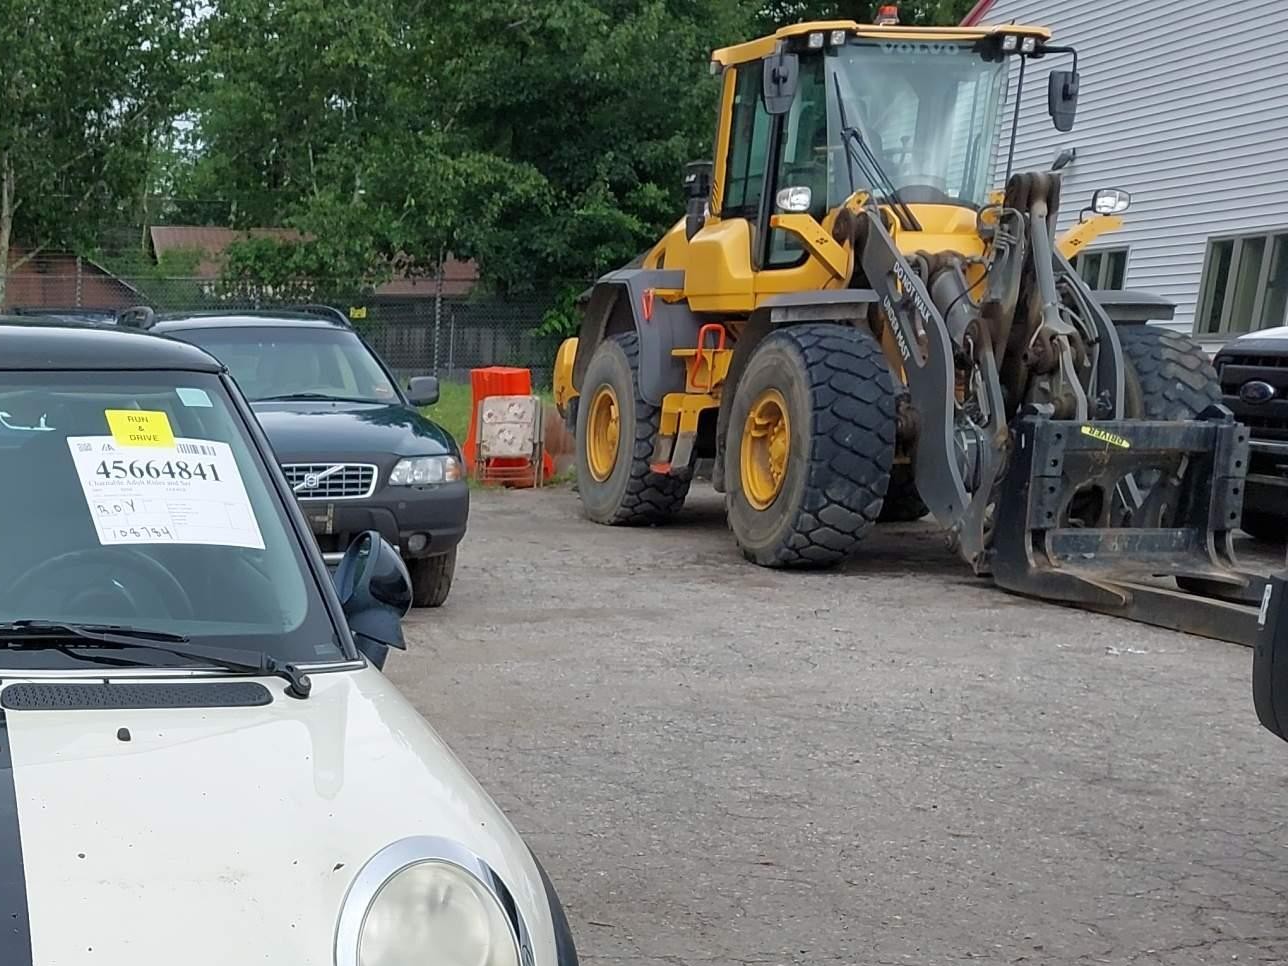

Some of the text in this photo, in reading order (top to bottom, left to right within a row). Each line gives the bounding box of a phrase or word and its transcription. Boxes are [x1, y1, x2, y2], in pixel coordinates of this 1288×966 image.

[878, 42, 959, 55] VOLVO
[893, 262, 932, 323] DO NOT WALK
[883, 295, 911, 361] UNDER MAST
[127, 415, 149, 423] RUN
[129, 434, 160, 442] DRIVE
[96, 459, 223, 482] 45664841
